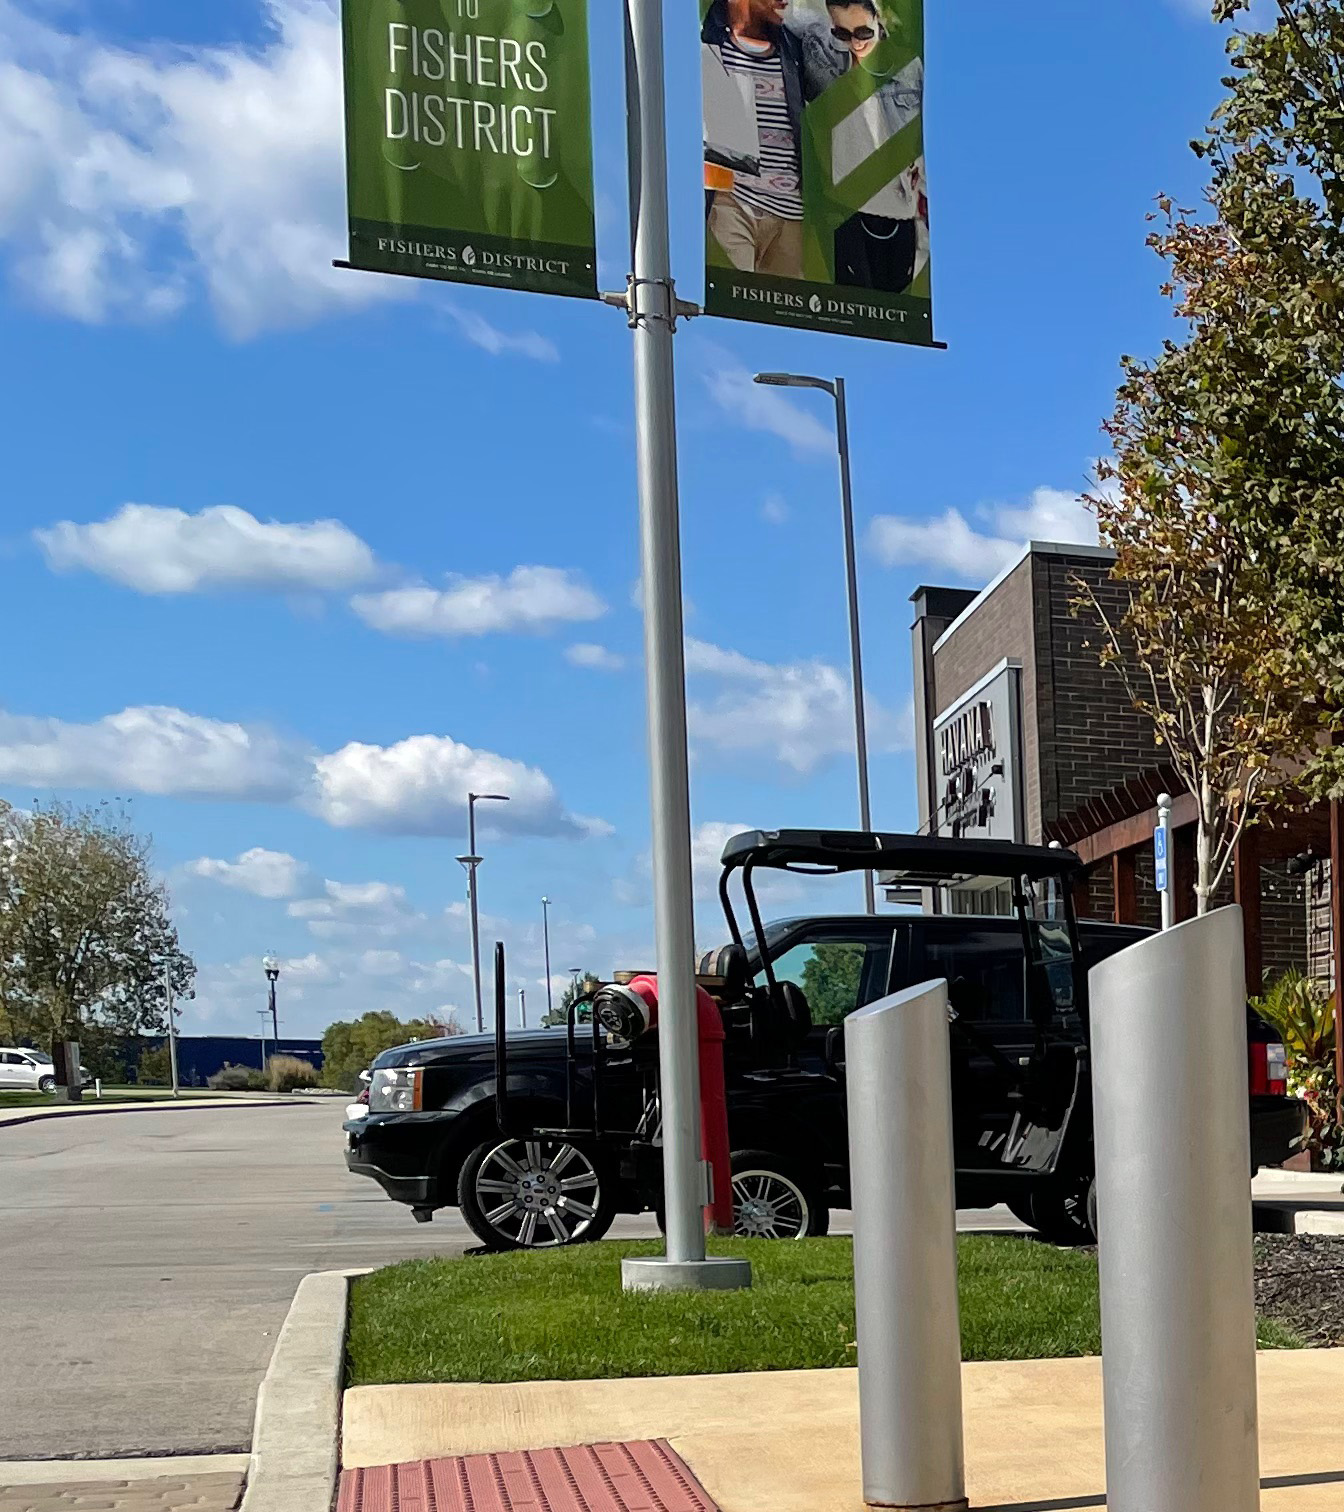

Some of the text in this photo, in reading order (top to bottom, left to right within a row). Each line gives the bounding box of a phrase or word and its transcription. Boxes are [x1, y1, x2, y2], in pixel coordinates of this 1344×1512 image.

[388, 22, 549, 93] FISHERS
[385, 87, 558, 159] DISTRICT
[377, 237, 457, 261] FISHERS
[481, 250, 570, 275] DISTRICT
[732, 285, 804, 309] FISHERS
[827, 299, 908, 323] DISTRICT
